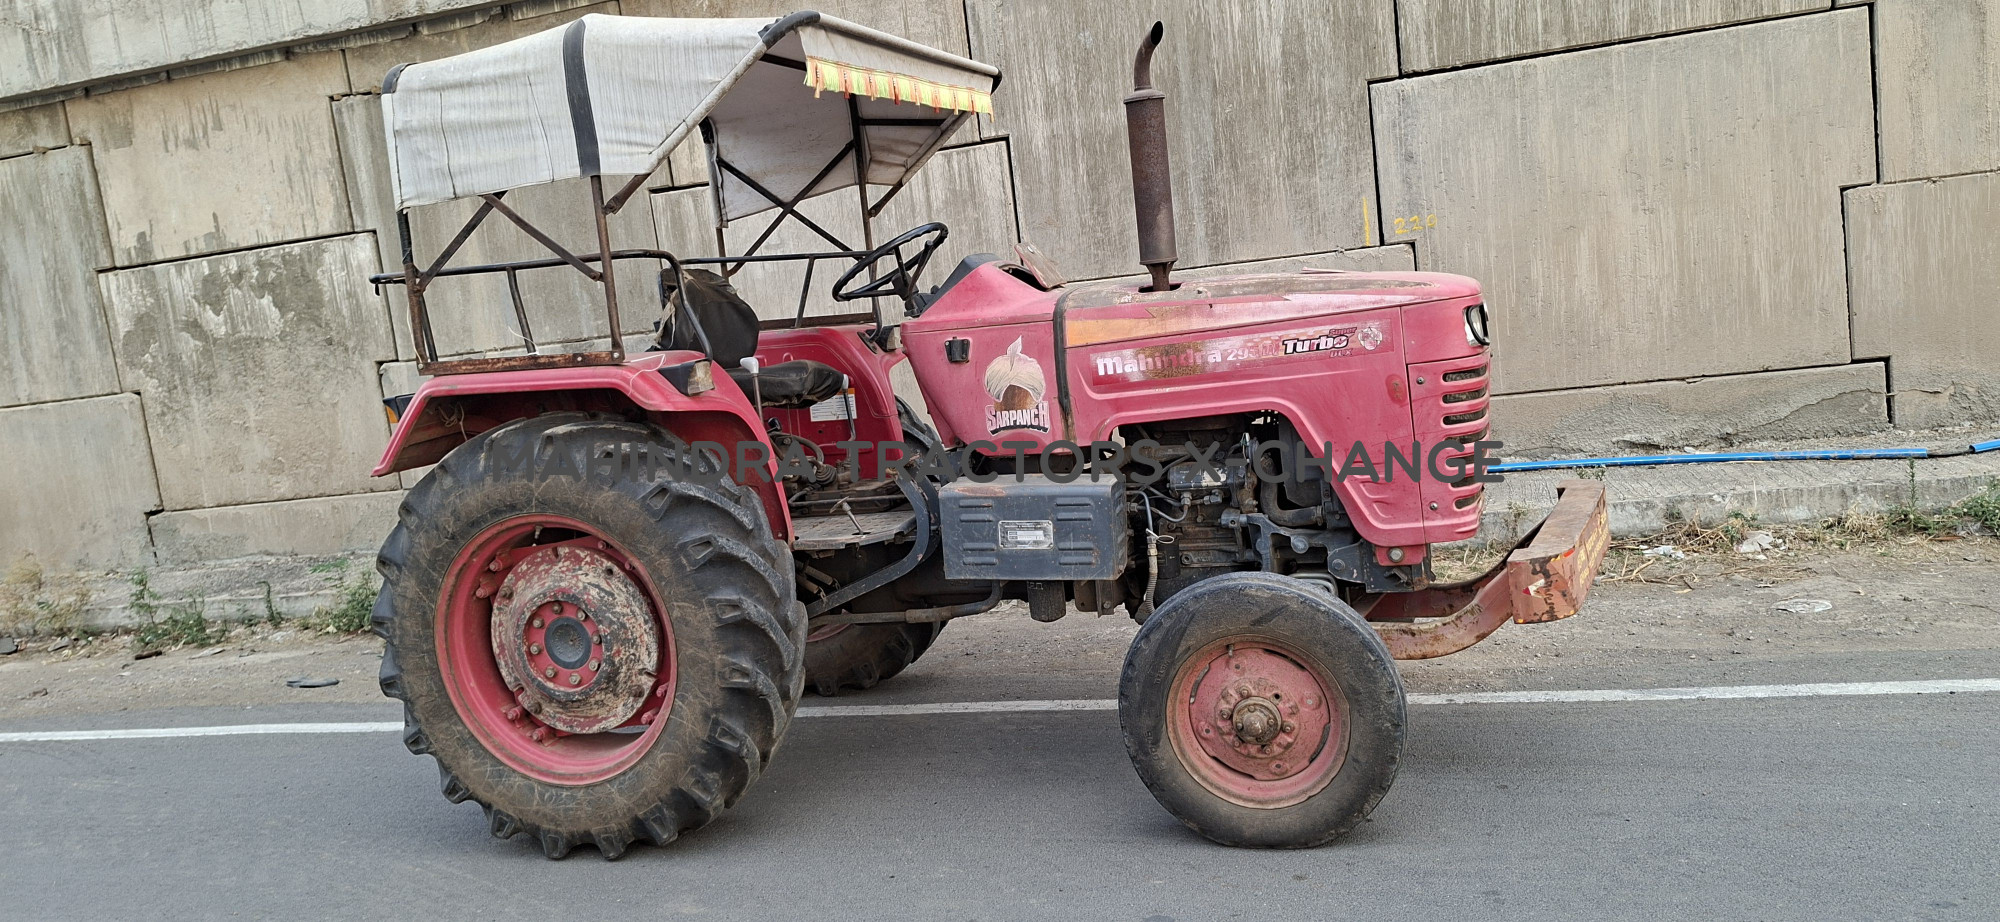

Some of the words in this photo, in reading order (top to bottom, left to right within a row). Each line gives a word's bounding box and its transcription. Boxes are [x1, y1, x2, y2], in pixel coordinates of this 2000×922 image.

[1394, 213, 1437, 235] 220
[1283, 335, 1349, 355] Turbo
[985, 401, 1050, 434] SARPANCH
